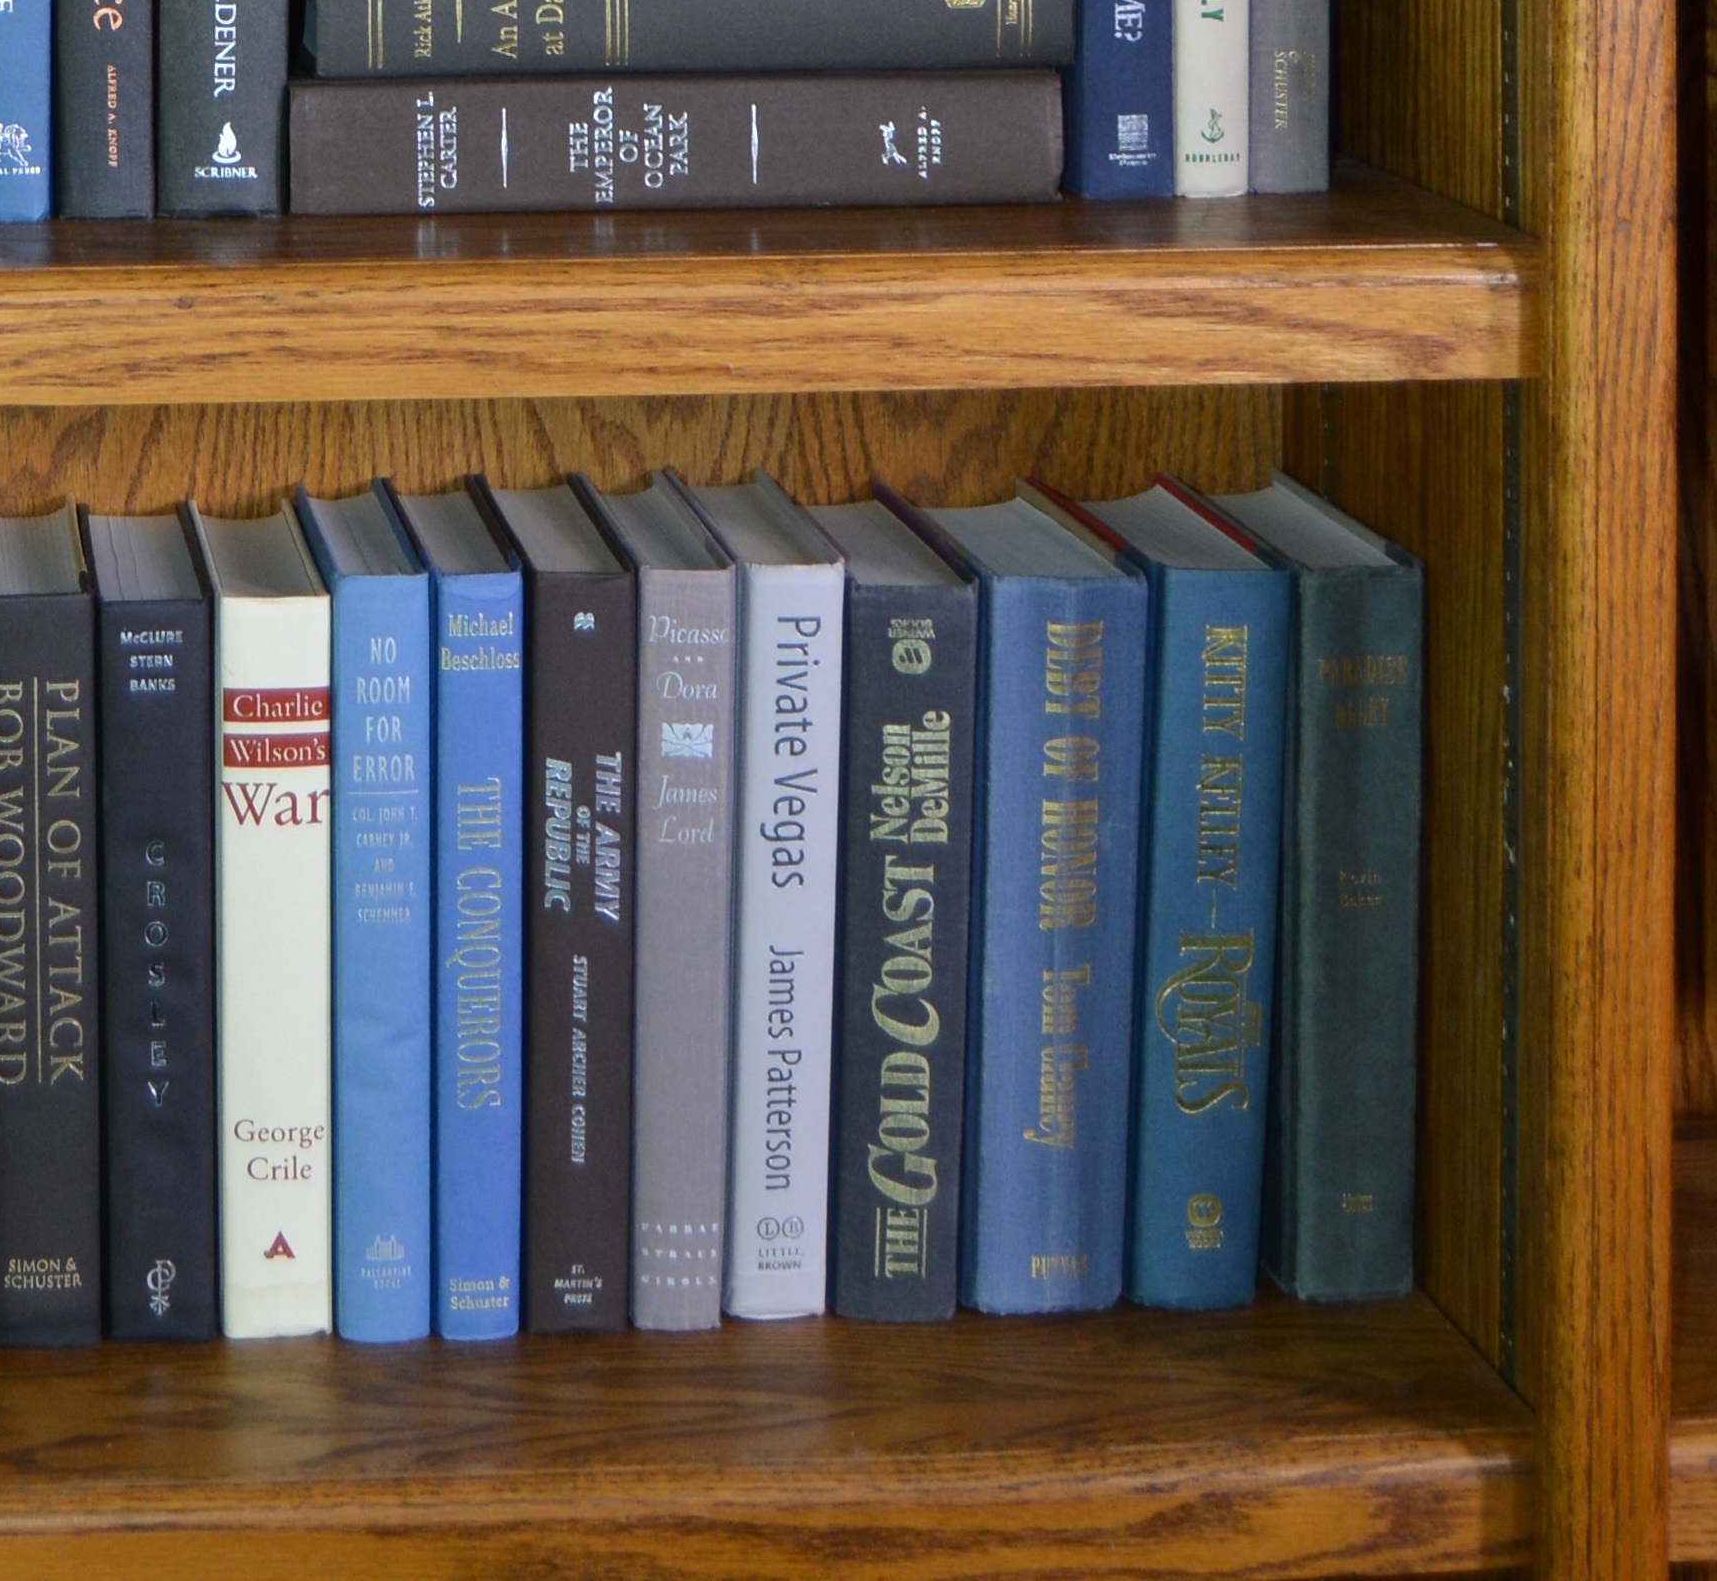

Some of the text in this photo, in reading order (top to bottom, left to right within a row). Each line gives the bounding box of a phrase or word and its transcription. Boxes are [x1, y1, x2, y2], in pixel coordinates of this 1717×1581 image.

[232, 694, 323, 719] Charlie
[230, 739, 326, 765] Wilson's
[222, 781, 329, 827] War
[46, 680, 83, 1086] PLAN OF ATTACK
[760, 617, 821, 1190] Private Vegas James Patterson
[234, 1119, 324, 1148] George
[247, 1155, 311, 1180] Crile
